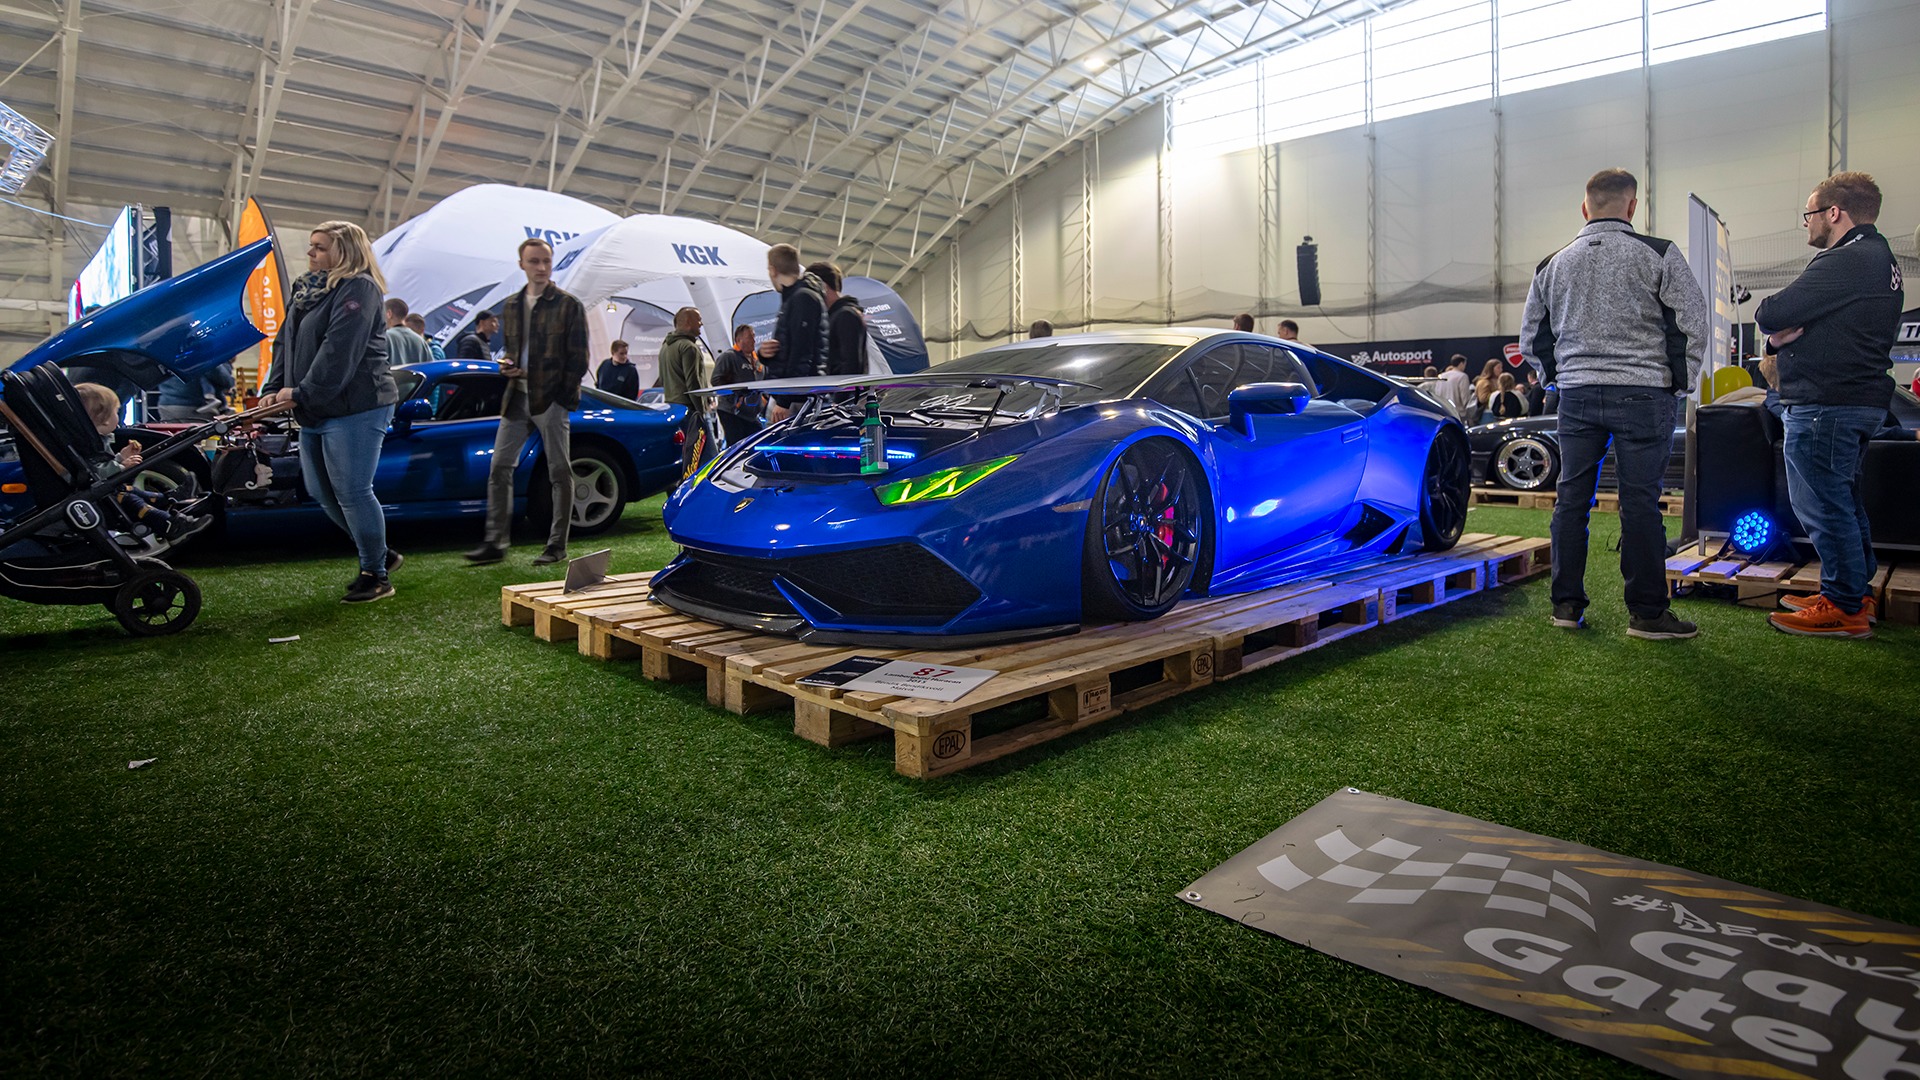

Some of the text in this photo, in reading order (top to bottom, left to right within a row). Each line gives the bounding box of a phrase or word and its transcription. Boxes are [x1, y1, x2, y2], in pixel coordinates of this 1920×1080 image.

[671, 243, 728, 267] KGK
[1373, 350, 1432, 363] Autosport
[913, 668, 955, 677] 87
[939, 734, 960, 755] EPAL
